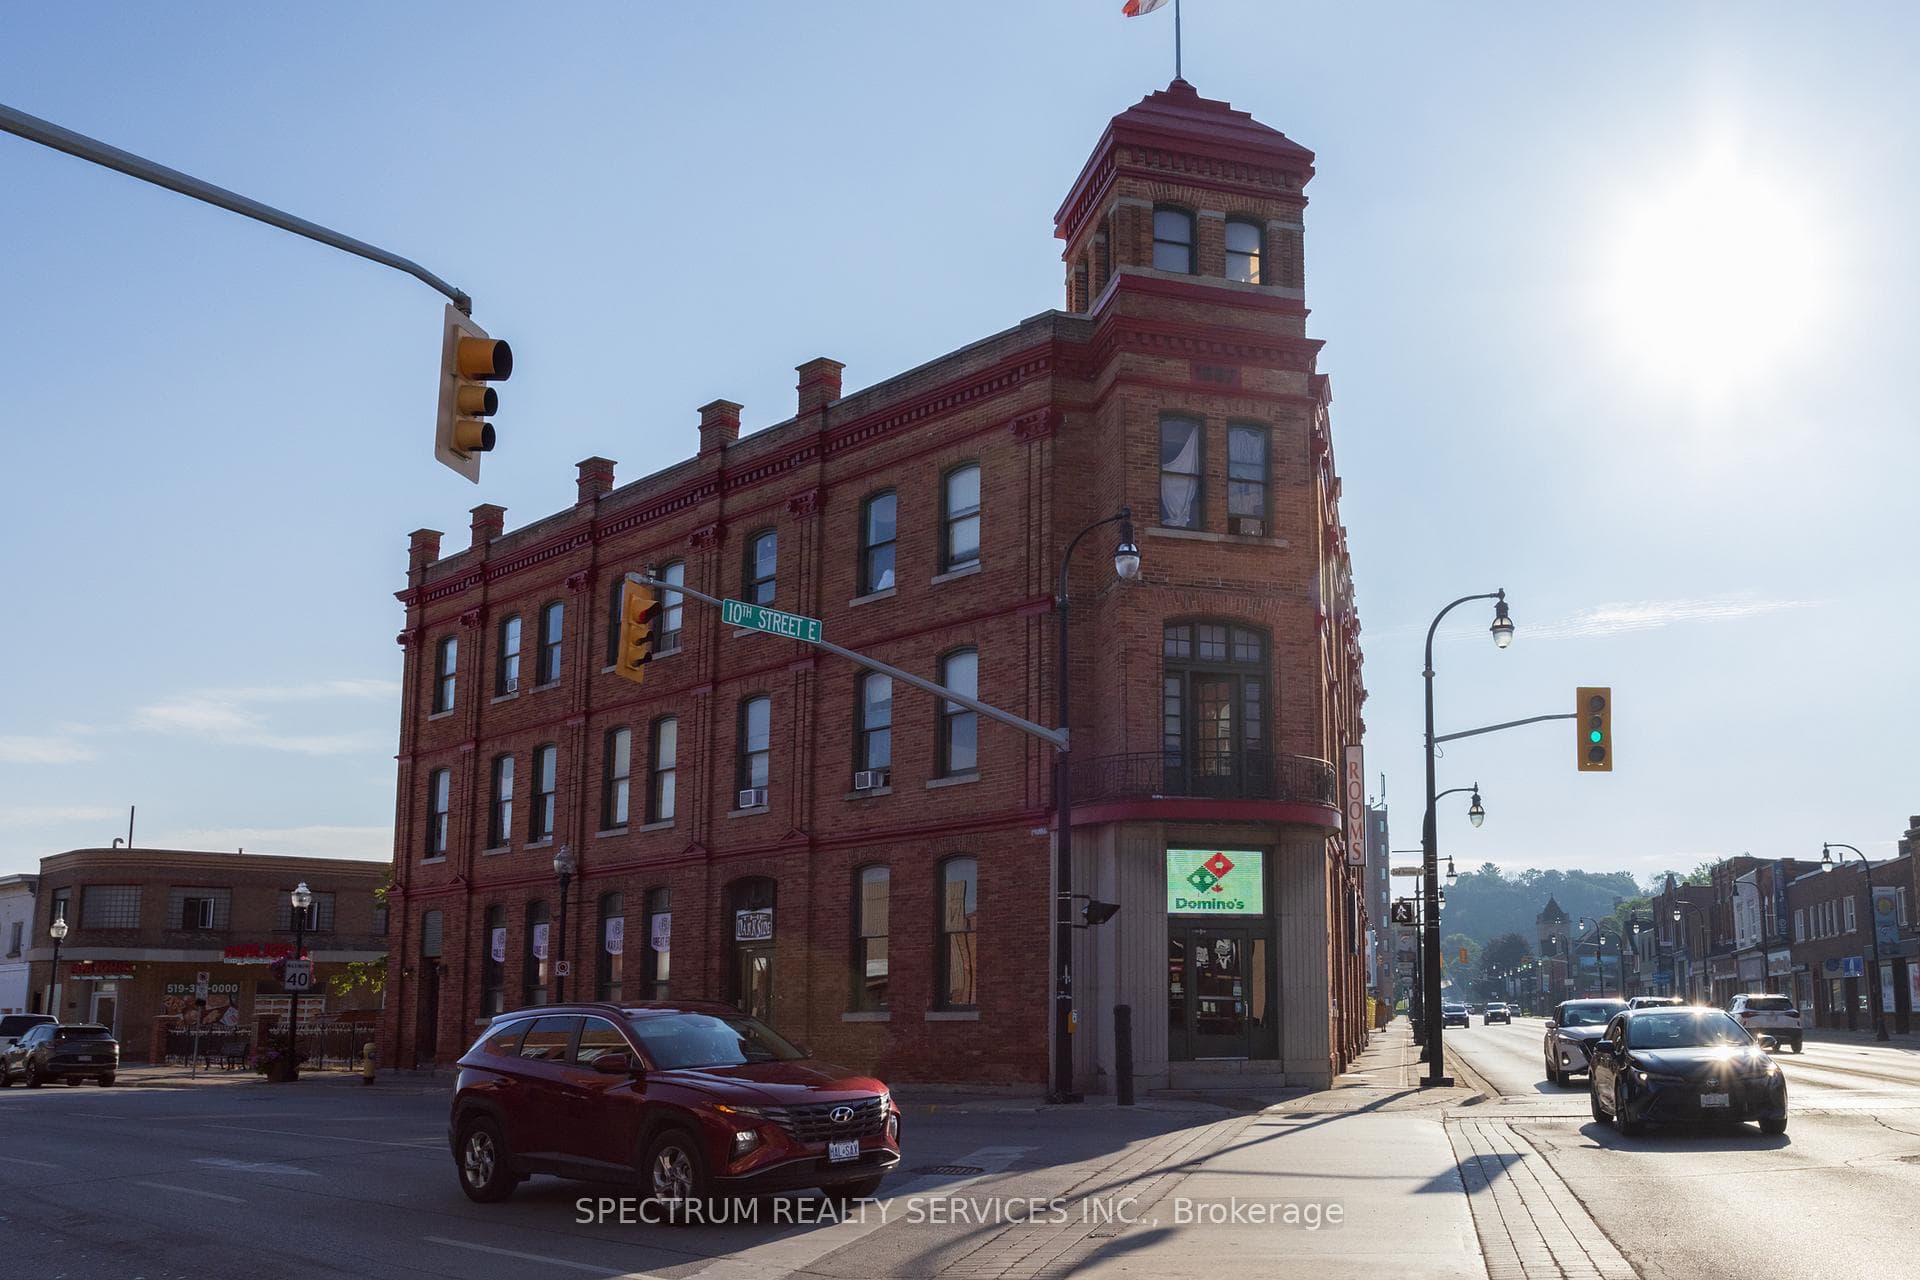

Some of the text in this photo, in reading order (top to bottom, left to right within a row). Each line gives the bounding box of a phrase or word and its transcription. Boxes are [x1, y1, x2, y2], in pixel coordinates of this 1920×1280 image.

[728, 602, 817, 640] 10TH STREET E
[1348, 761, 1364, 861] ROOMS
[1175, 897, 1245, 910] Domino's
[737, 912, 770, 921] THE
[286, 972, 308, 986] 40
[167, 984, 238, 993] 519-3-0000
